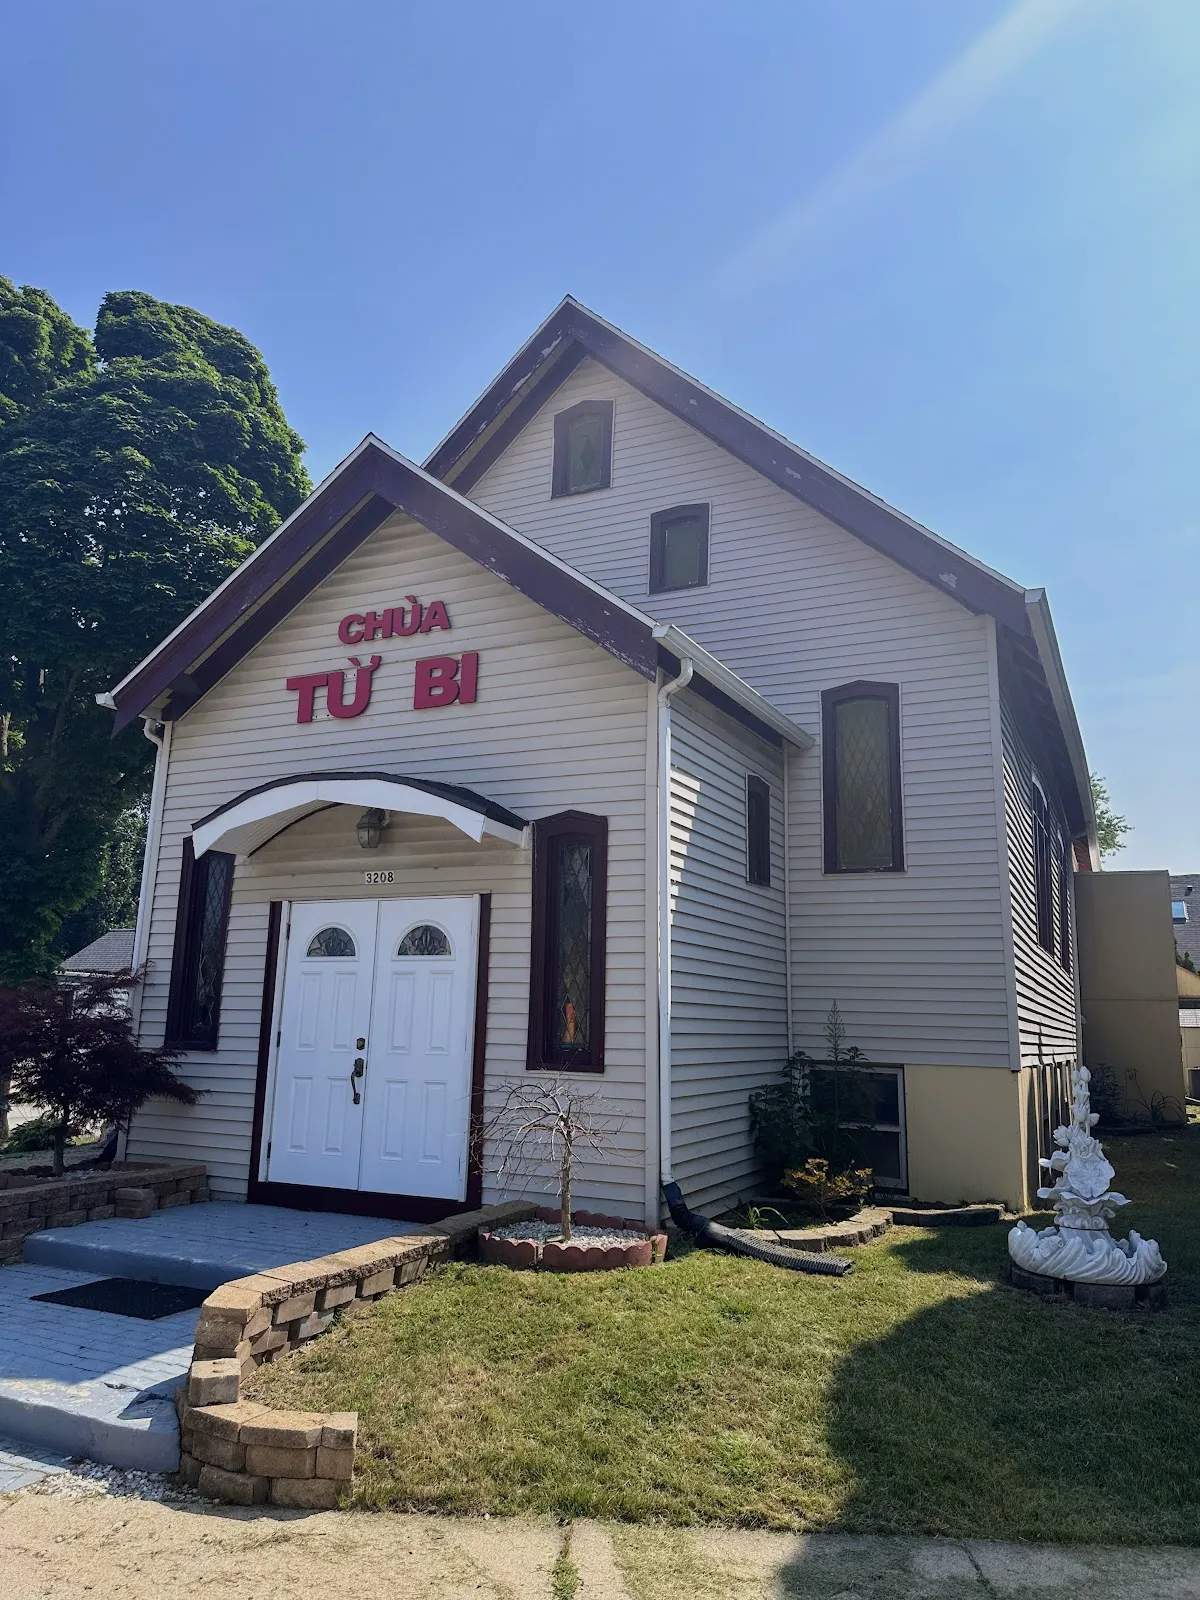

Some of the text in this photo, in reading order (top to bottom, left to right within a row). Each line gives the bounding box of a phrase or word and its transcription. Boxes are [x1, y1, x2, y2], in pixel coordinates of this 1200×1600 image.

[338, 595, 451, 644] CHÙA
[286, 652, 479, 724] TỪ BI
[366, 871, 394, 884] 3208
